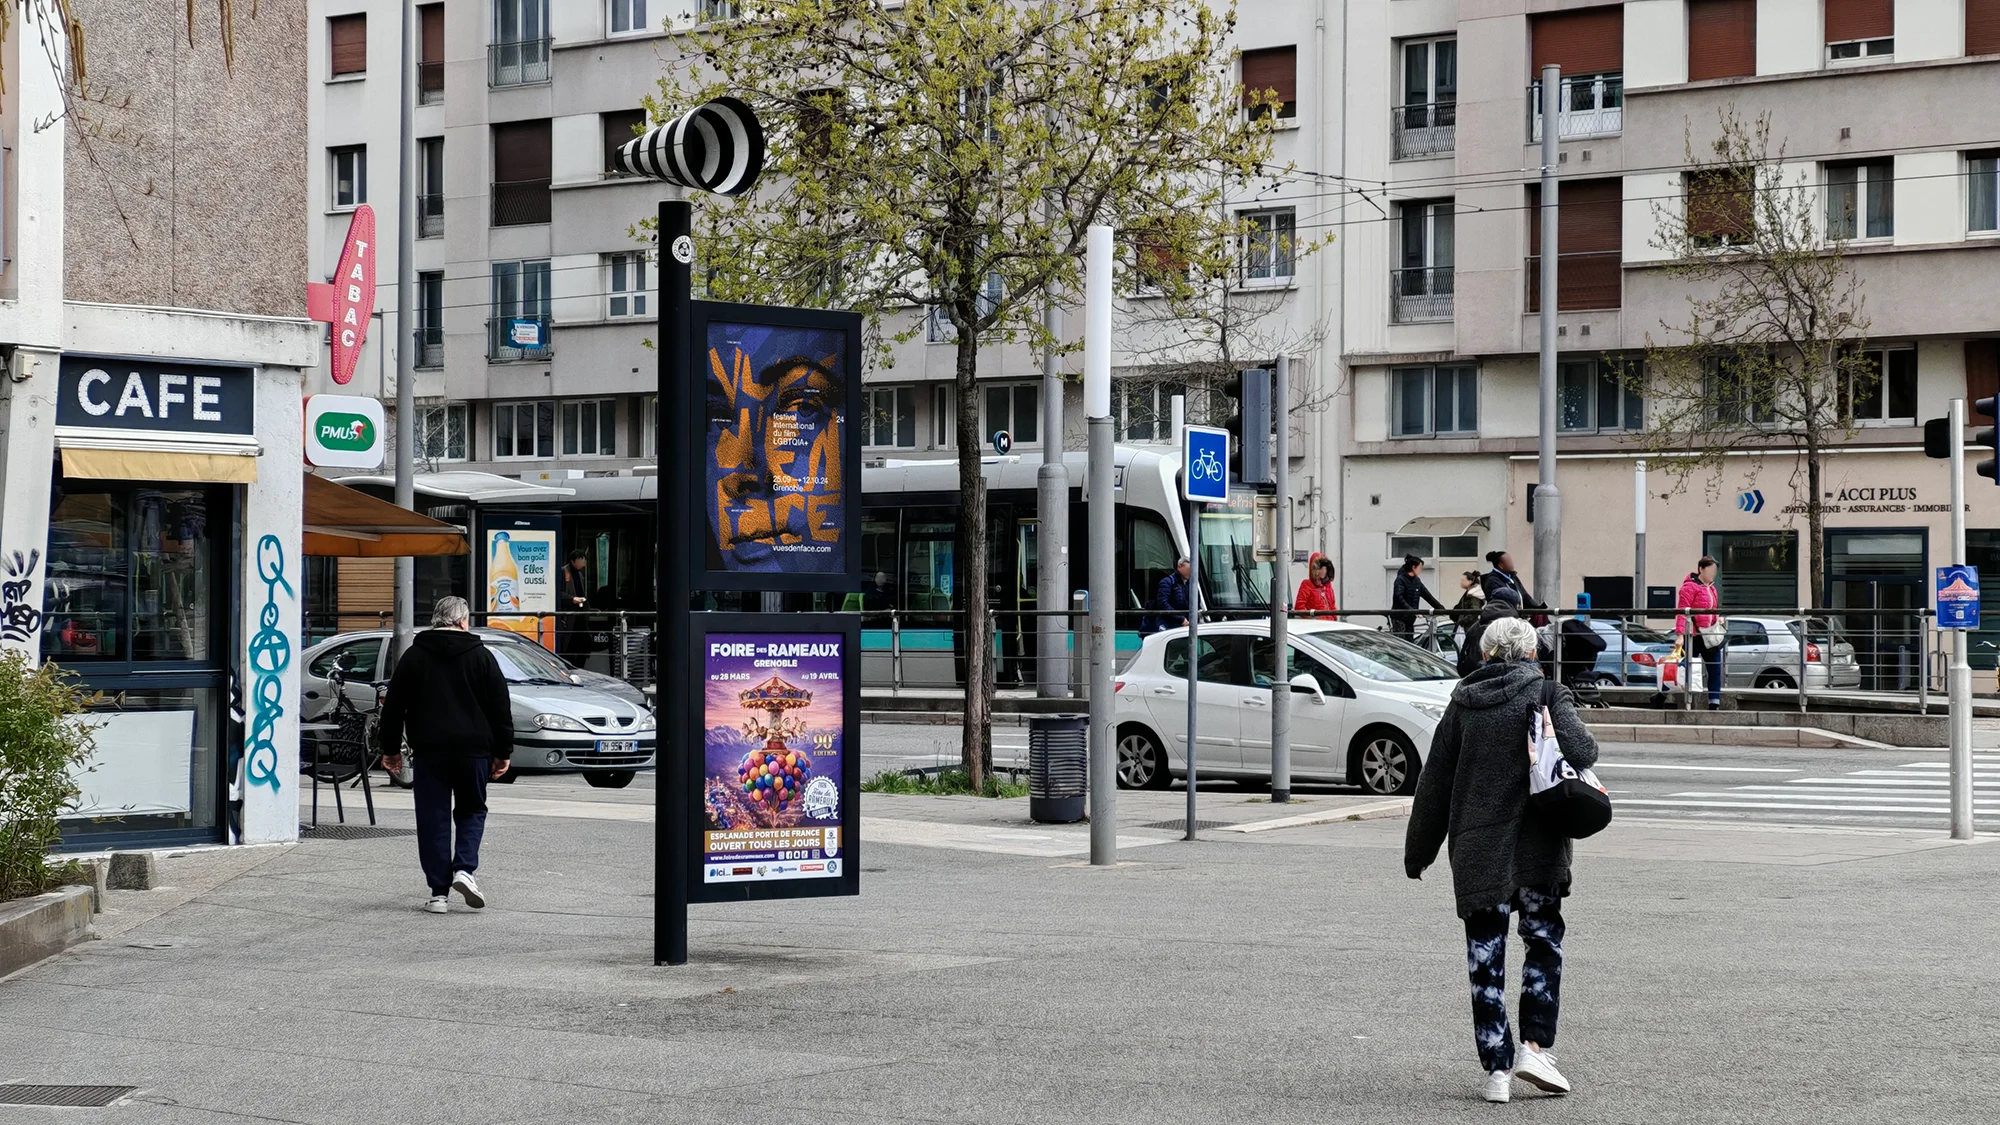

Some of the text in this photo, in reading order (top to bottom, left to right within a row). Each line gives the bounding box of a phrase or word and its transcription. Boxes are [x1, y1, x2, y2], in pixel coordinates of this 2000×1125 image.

[341, 240, 369, 347] TABAC
[77, 368, 222, 421] CAFE
[773, 413, 797, 421] festival
[836, 415, 845, 424] 24
[773, 422, 815, 430] international
[321, 425, 349, 440] PMU
[773, 430, 796, 438] du film
[773, 438, 808, 446] LGBTQIA+
[773, 475, 829, 485] 25.09 12.10.24
[773, 484, 803, 492] Grenoble
[1838, 487, 1917, 501] ACCI PLUS
[1784, 504, 1970, 513] PATROINE ASSURANCES IMMOBILR
[772, 545, 831, 553] vuesdenface.com
[523, 564, 544, 574] Elles
[524, 574, 547, 585] aussi.
[711, 643, 755, 656] FOIRE
[768, 643, 839, 657] RAMEAUX
[754, 659, 798, 667] GRENOBLE
[818, 672, 839, 680] AVRIL
[710, 829, 820, 840] ESPLANADE PORTE DE FRANCE
[710, 841, 746, 851] OUVERT
[748, 840, 772, 849] TOUS
[774, 840, 790, 848] LES
[792, 838, 820, 847] JOURS
[710, 853, 775, 861] www.foiredesrameaux.com
